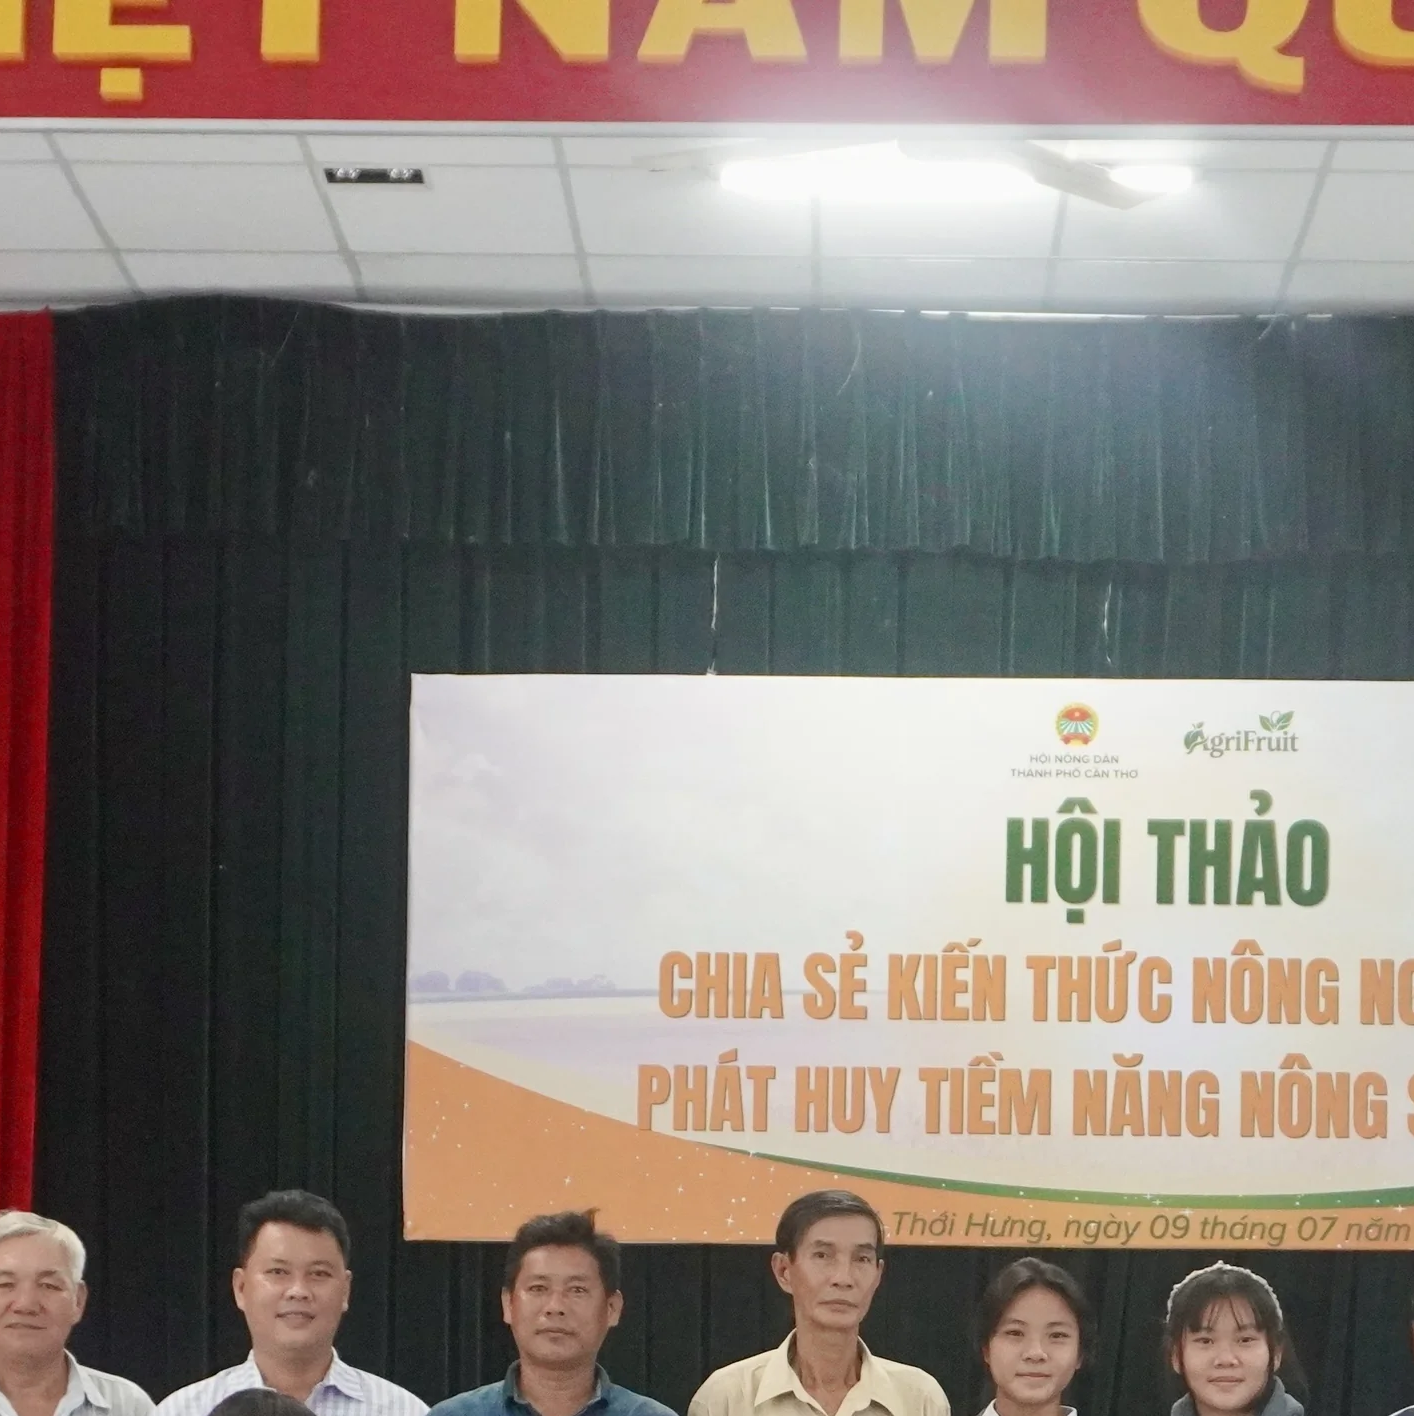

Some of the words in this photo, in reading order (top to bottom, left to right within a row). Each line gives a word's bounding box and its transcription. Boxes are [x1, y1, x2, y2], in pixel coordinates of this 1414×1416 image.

[1184, 728, 1299, 758] AgriFruit
[1005, 797, 1121, 924] HỘI
[1147, 789, 1330, 907] THẢO
[658, 951, 784, 1019] CHIA
[803, 930, 868, 1020] SẺ
[888, 938, 1006, 1022] KIẾN
[1027, 939, 1172, 1024] THỨC
[1193, 939, 1340, 1026] NÔNG
[637, 1048, 776, 1132] PHÁT
[795, 1065, 901, 1134] HUY
[919, 1051, 1053, 1136] TIỀM
[1073, 1052, 1220, 1138] NĂNG
[1240, 1053, 1388, 1140] NÔNG
[892, 1211, 955, 1237] Thới
[964, 1211, 1053, 1244] Hưng,
[1063, 1213, 1141, 1246] ngày
[1149, 1214, 1191, 1240] 09
[1199, 1215, 1287, 1248] tháng
[1297, 1216, 1339, 1242] 07
[1344, 1217, 1411, 1243] năm
